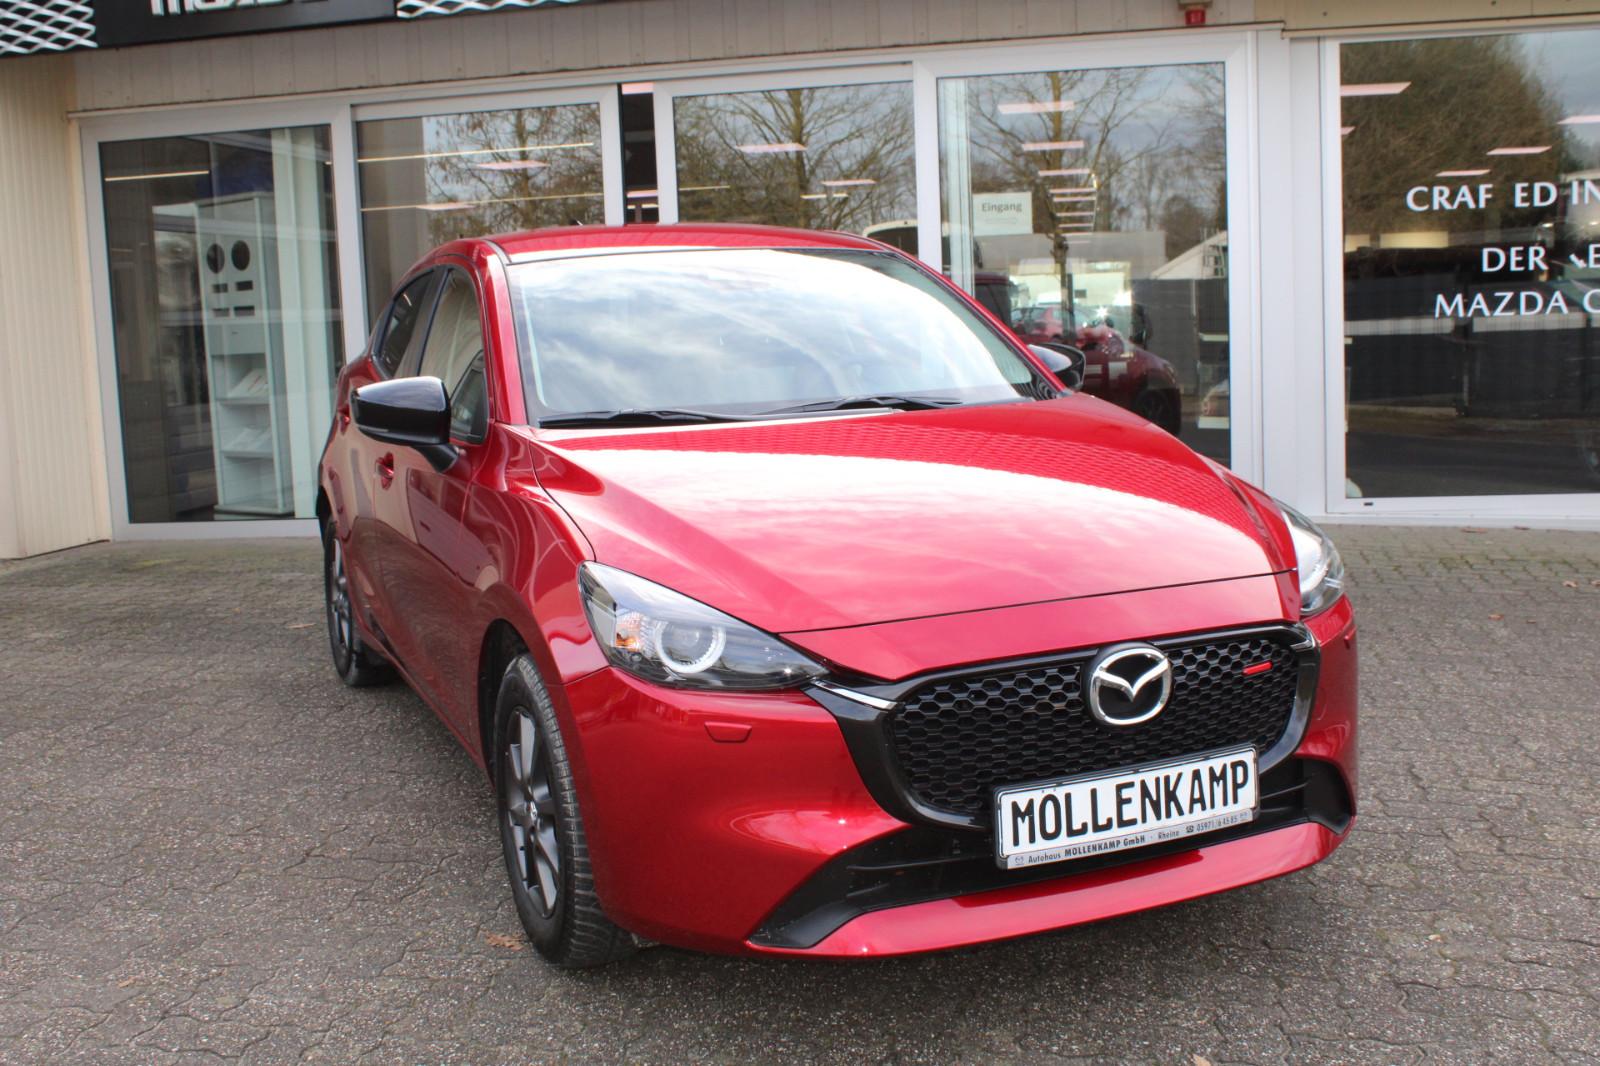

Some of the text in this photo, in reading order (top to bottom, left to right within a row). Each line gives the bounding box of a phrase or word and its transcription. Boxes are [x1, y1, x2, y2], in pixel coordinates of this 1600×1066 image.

[981, 202, 1023, 213] Eingang
[1482, 246, 1549, 272] DER
[1434, 290, 1569, 318] MAZDA
[1028, 852, 1061, 863] Autohaus
[1123, 835, 1146, 846] GmbH
